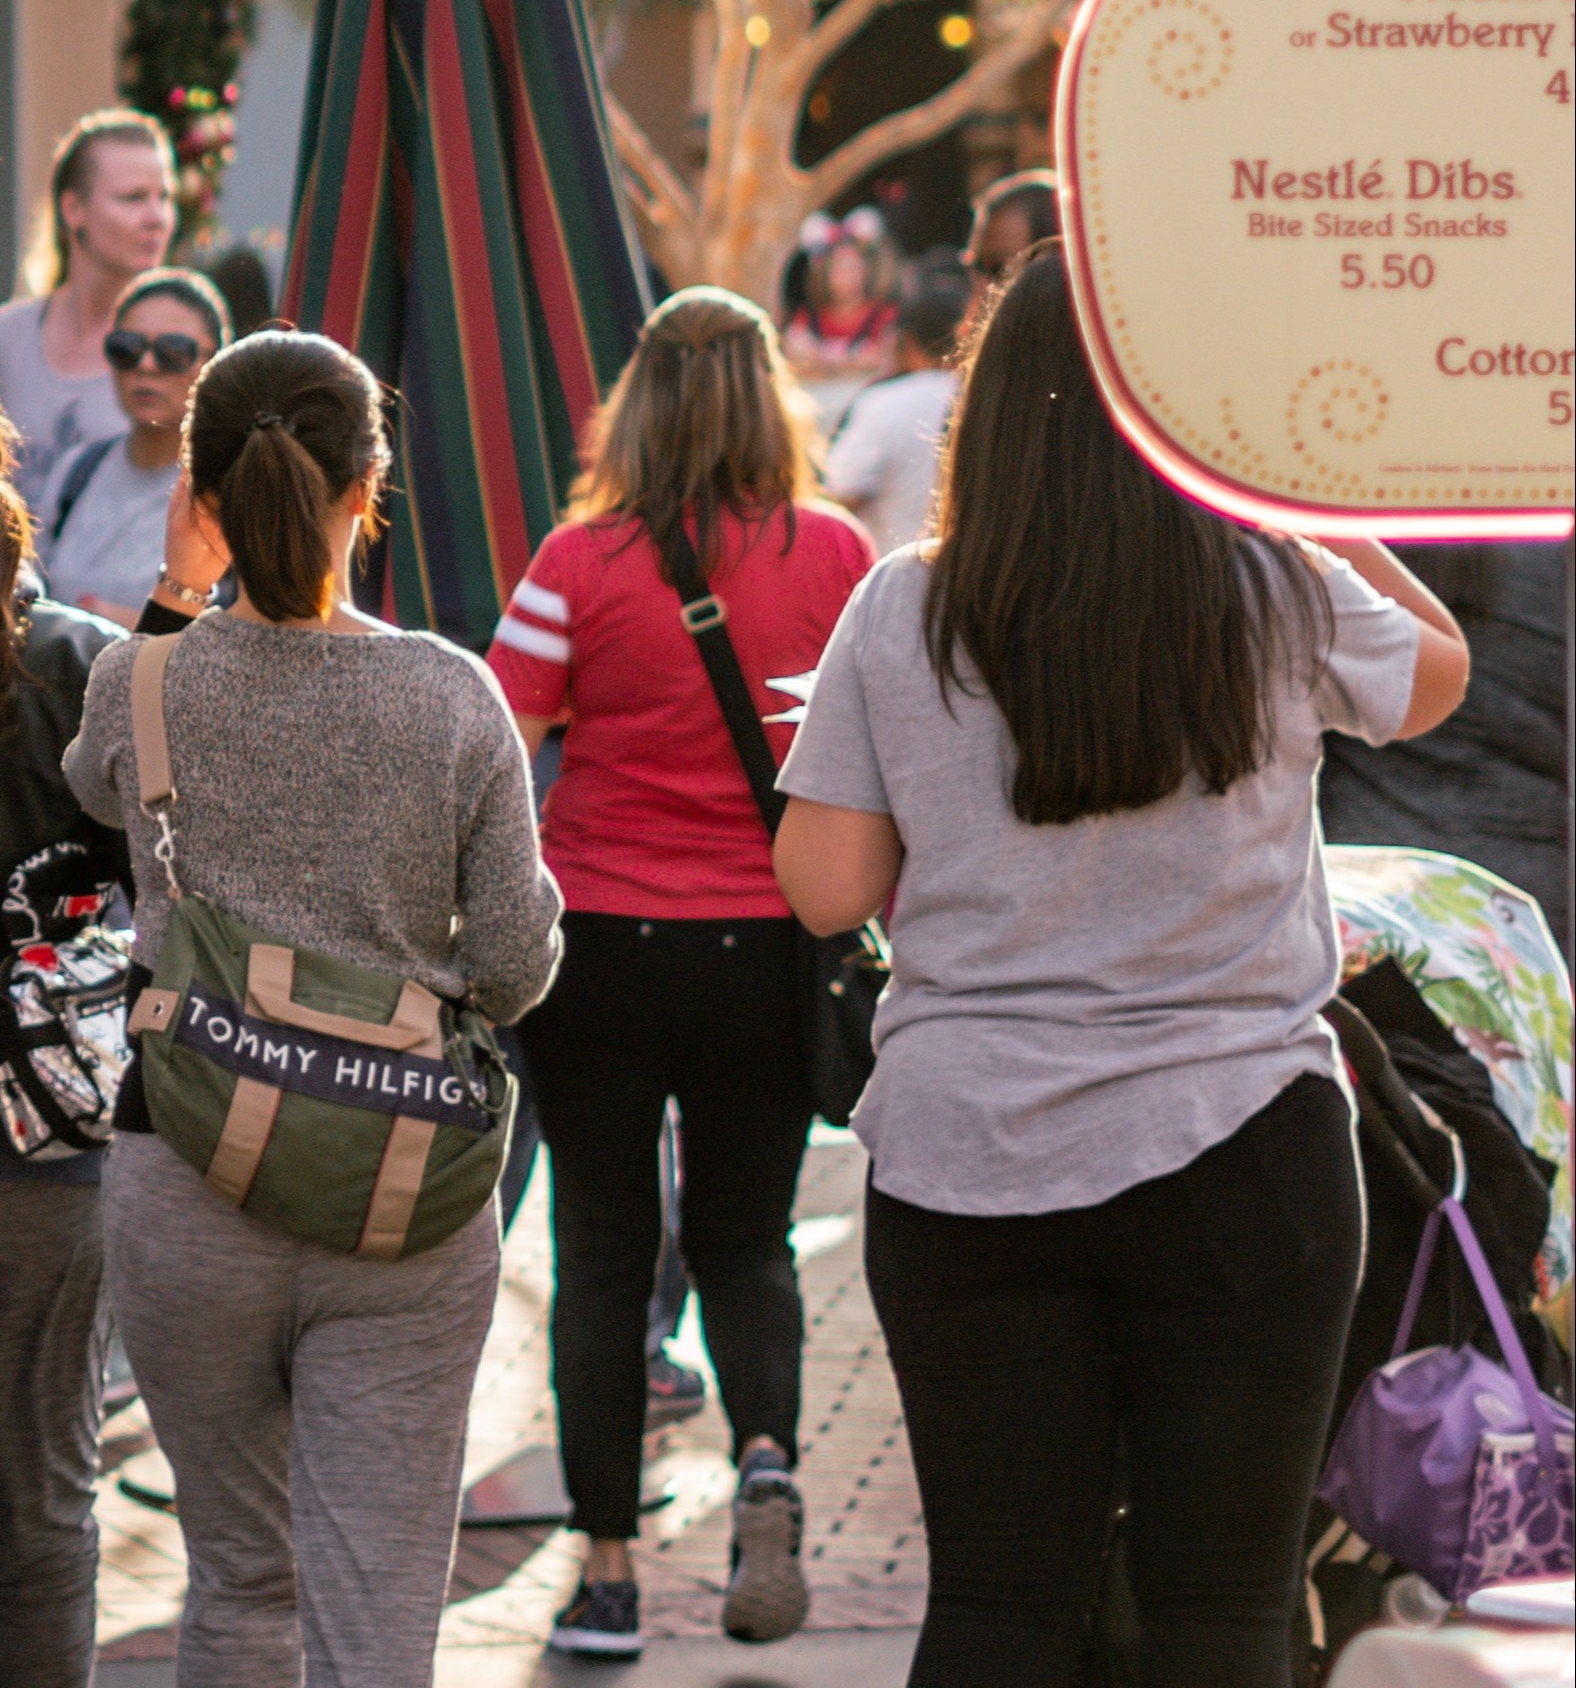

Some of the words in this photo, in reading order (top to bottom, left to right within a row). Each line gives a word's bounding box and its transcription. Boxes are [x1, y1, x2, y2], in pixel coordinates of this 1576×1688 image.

[1288, 30, 1318, 48] or
[1325, 11, 1556, 58] Strawberry
[1230, 158, 1385, 201] Nestlé
[1404, 158, 1517, 201] Dibs
[1247, 212, 1304, 238] Bite
[1313, 212, 1394, 238] Sized
[1404, 211, 1509, 238] Snacks
[1339, 253, 1436, 290] 5.50
[190, 997, 317, 1074] TOMMY
